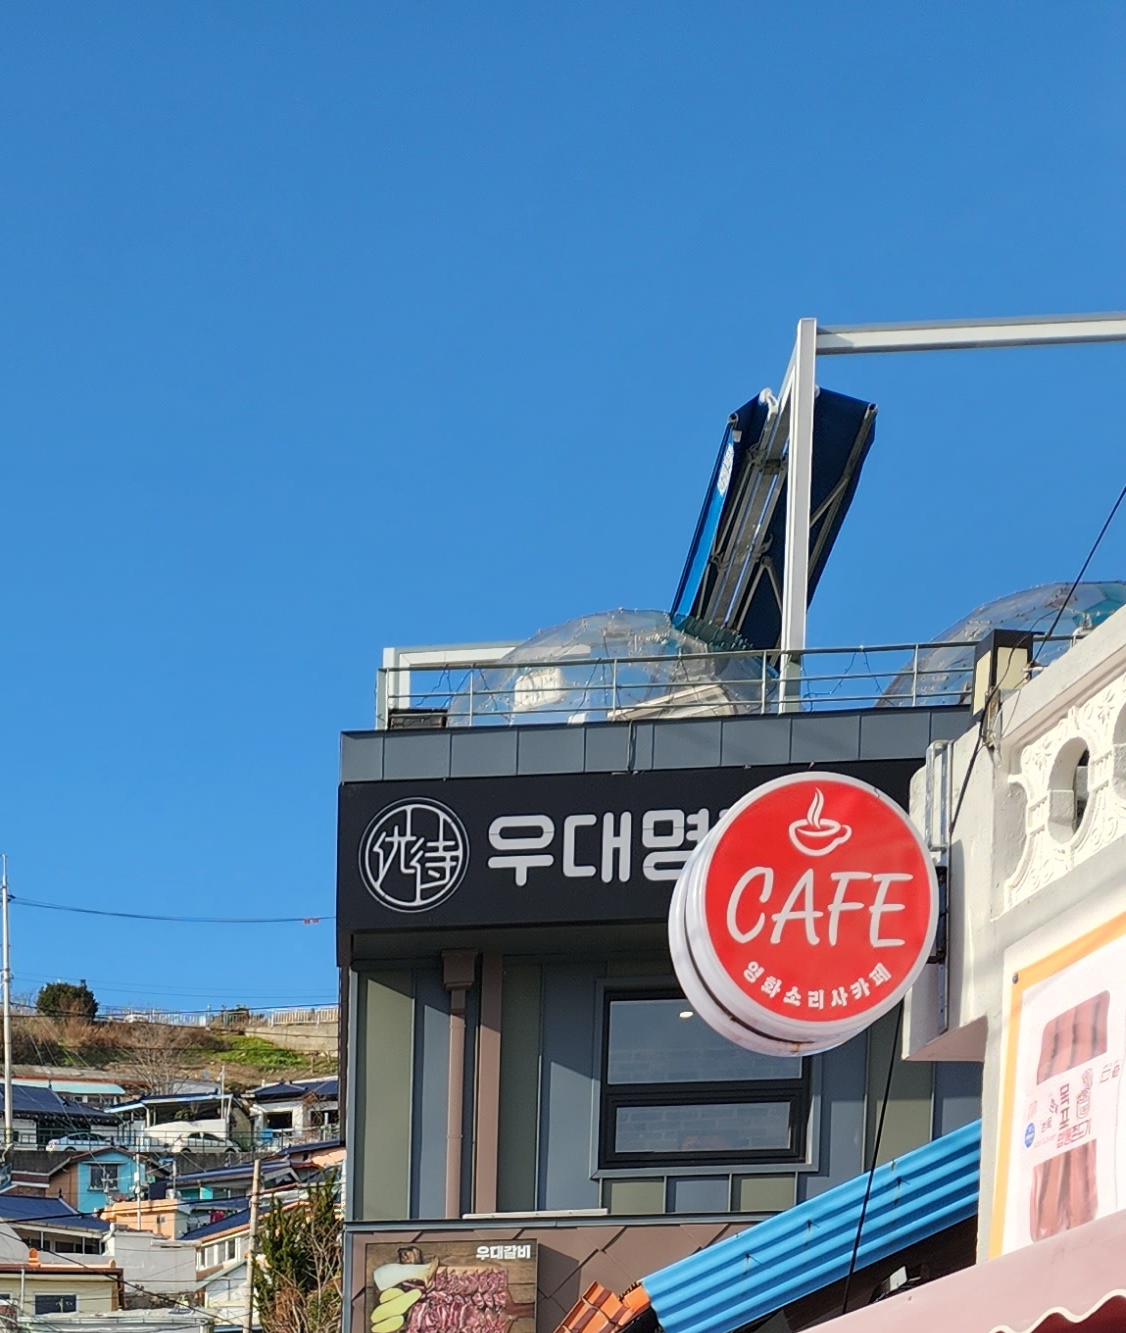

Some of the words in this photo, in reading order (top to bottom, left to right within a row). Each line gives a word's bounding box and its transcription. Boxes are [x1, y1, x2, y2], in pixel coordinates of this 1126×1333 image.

[488, 808, 728, 888] 우대명
[726, 866, 913, 948] CAFE
[476, 1244, 531, 1260] 우대갈비
